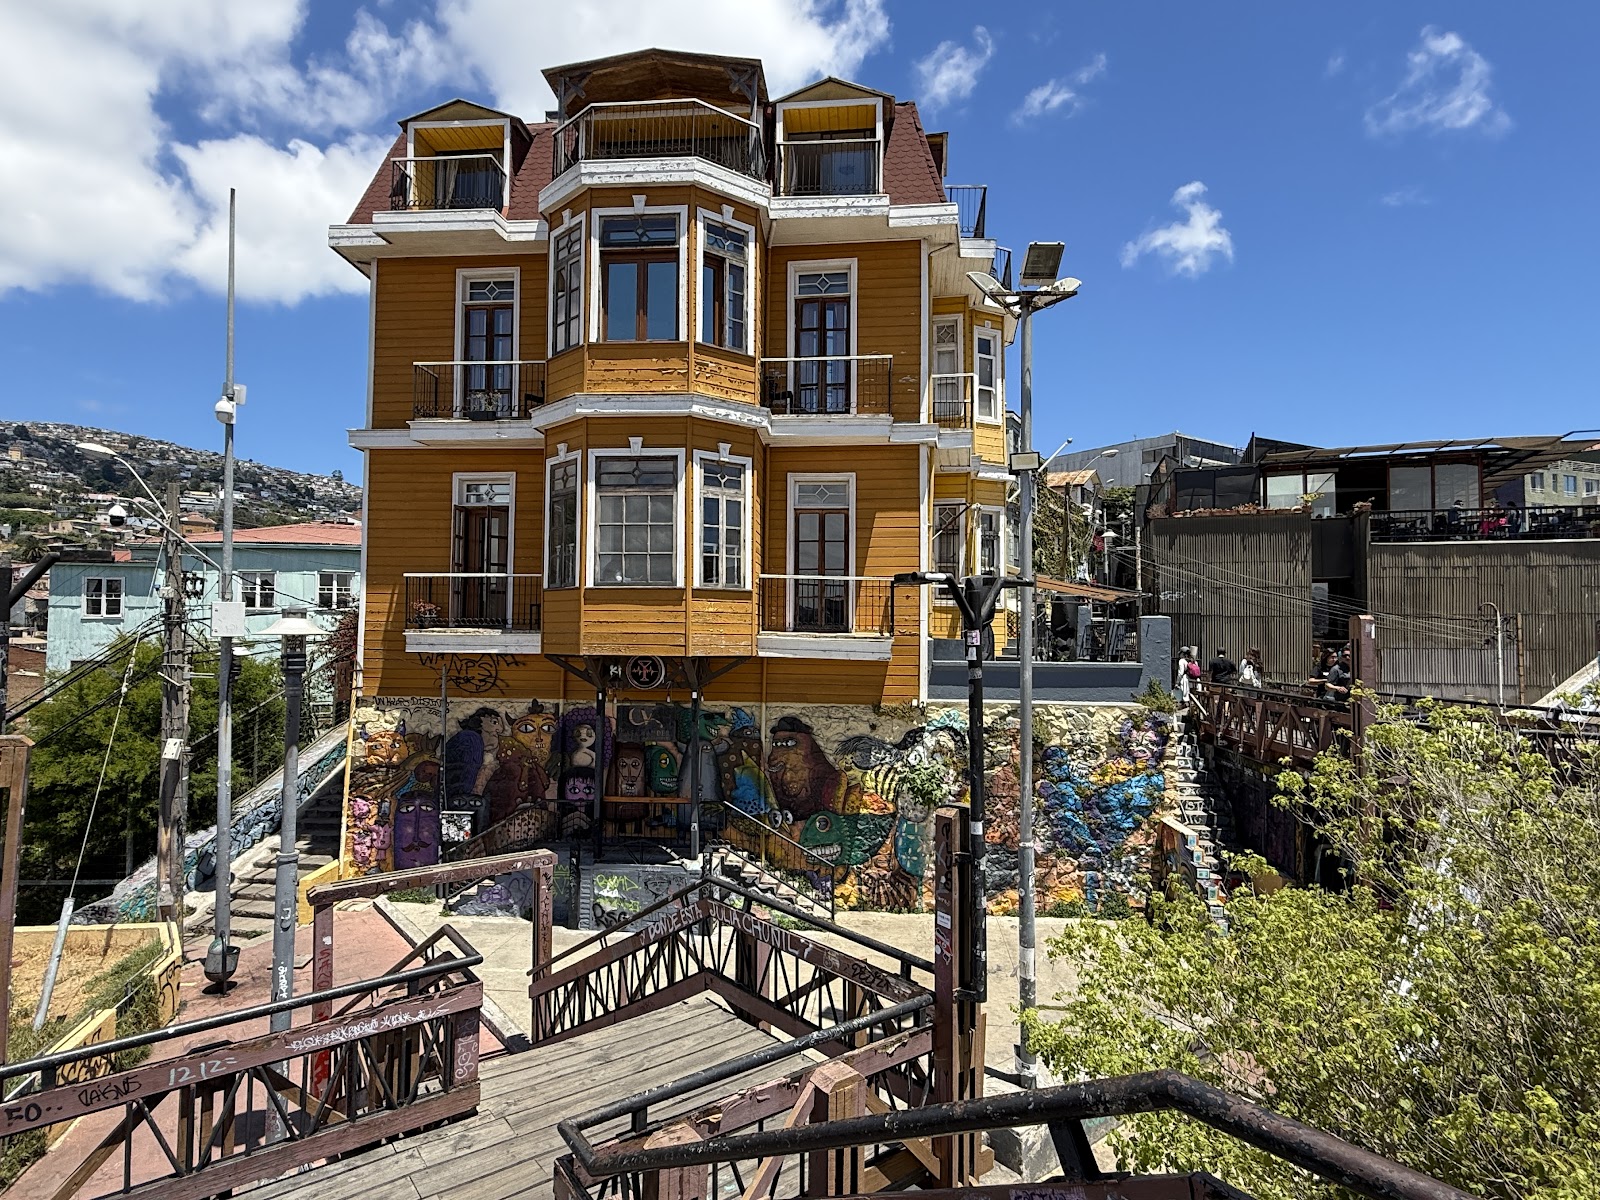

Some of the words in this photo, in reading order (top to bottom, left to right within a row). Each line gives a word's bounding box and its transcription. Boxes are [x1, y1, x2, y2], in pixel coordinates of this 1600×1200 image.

[648, 911, 682, 941] DONDE
[680, 902, 703, 926] ESTA
[709, 902, 742, 929] JULIA
